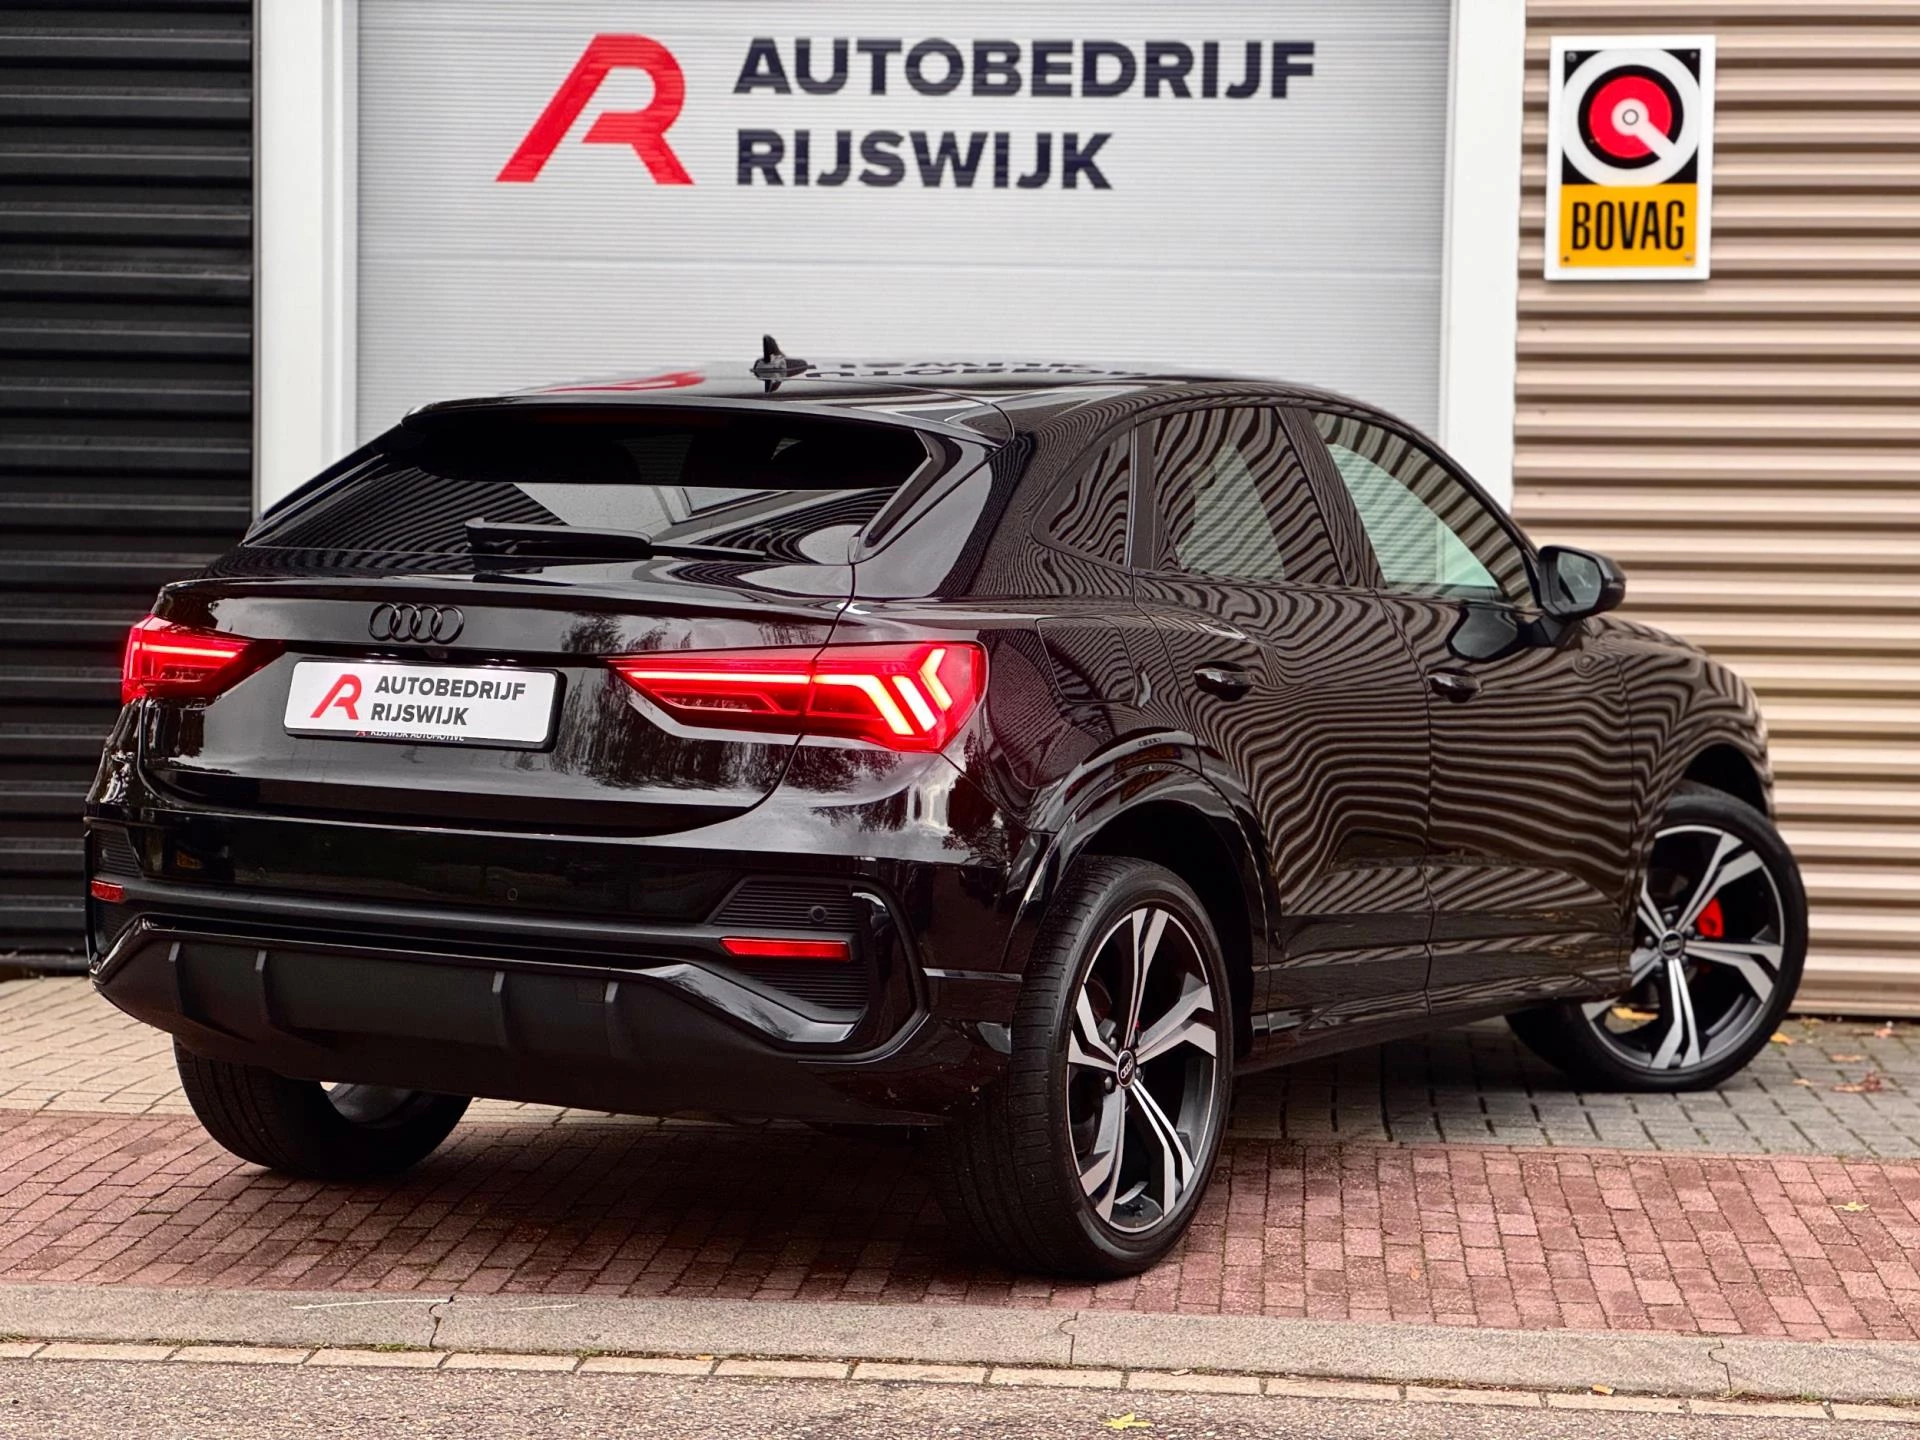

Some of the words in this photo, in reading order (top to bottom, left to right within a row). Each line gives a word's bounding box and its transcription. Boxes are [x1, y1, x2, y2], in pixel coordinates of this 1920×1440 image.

[733, 37, 1315, 99] AUTOBEDRIJF
[737, 128, 1113, 190] RIJSWIJK
[1571, 200, 1685, 251] BOVAG
[374, 675, 527, 701] AUTOBEDRIJF
[370, 703, 470, 726] RIJSWIJK
